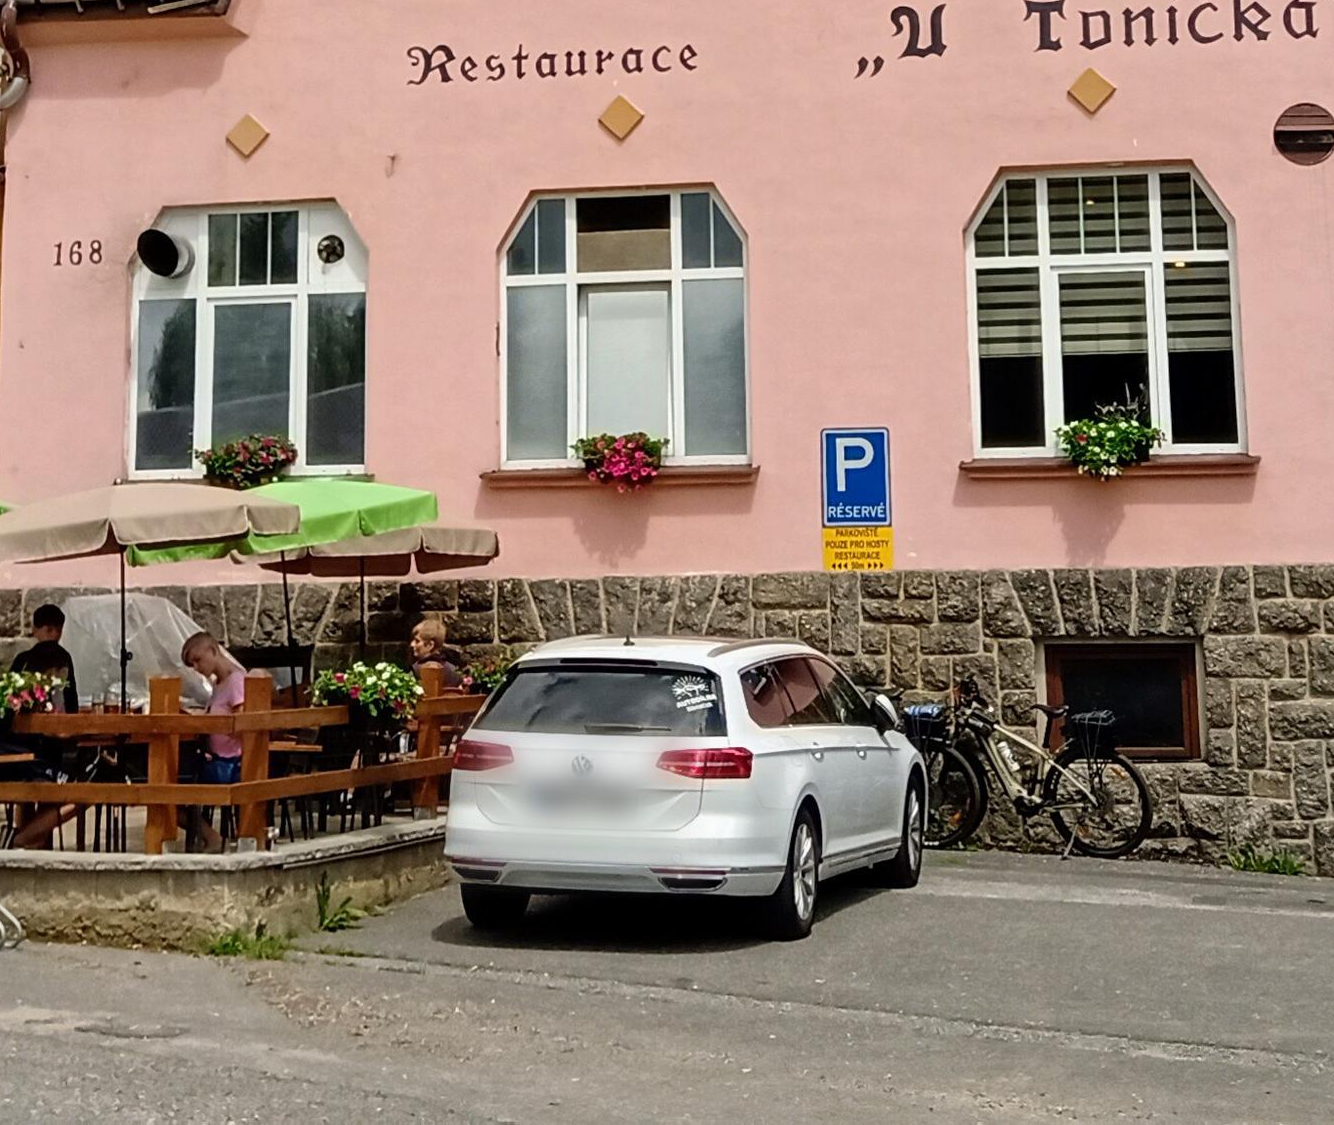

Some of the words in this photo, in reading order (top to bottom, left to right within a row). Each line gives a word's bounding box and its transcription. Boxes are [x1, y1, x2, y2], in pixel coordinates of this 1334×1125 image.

[406, 44, 698, 86] Restaurace
[54, 239, 103, 266] 168
[835, 437, 874, 492] P
[828, 502, 885, 518] RÉSERVÉ
[825, 540, 848, 549] POUZE
[849, 540, 865, 549] PRO
[865, 539, 889, 548] HOSTY
[834, 551, 880, 560] RESTAURACE
